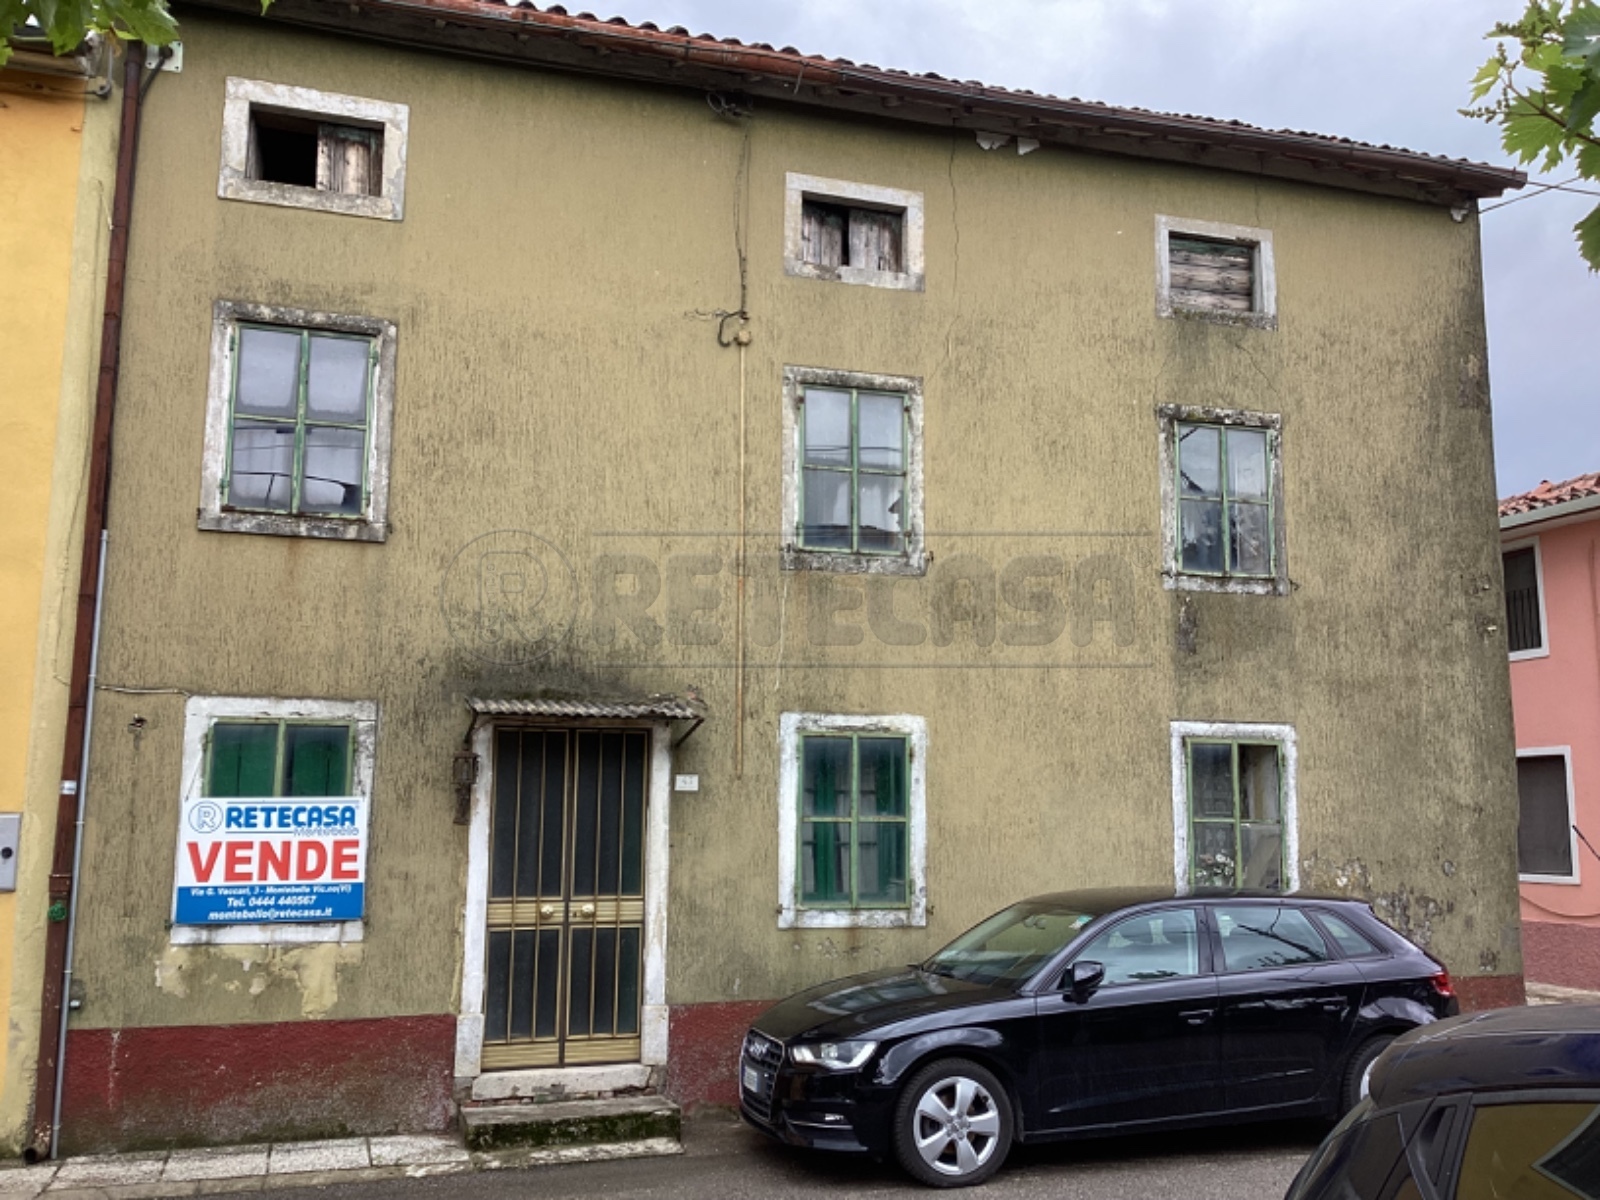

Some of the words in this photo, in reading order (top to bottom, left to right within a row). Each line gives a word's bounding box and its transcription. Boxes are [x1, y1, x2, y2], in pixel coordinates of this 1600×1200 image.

[225, 805, 356, 829] RETECASA
[186, 839, 360, 883] VENDE
[190, 888, 204, 896] Via
[227, 897, 246, 908] Tel.
[249, 896, 275, 907] 0444
[208, 907, 332, 921] montebello@retecasa.it
